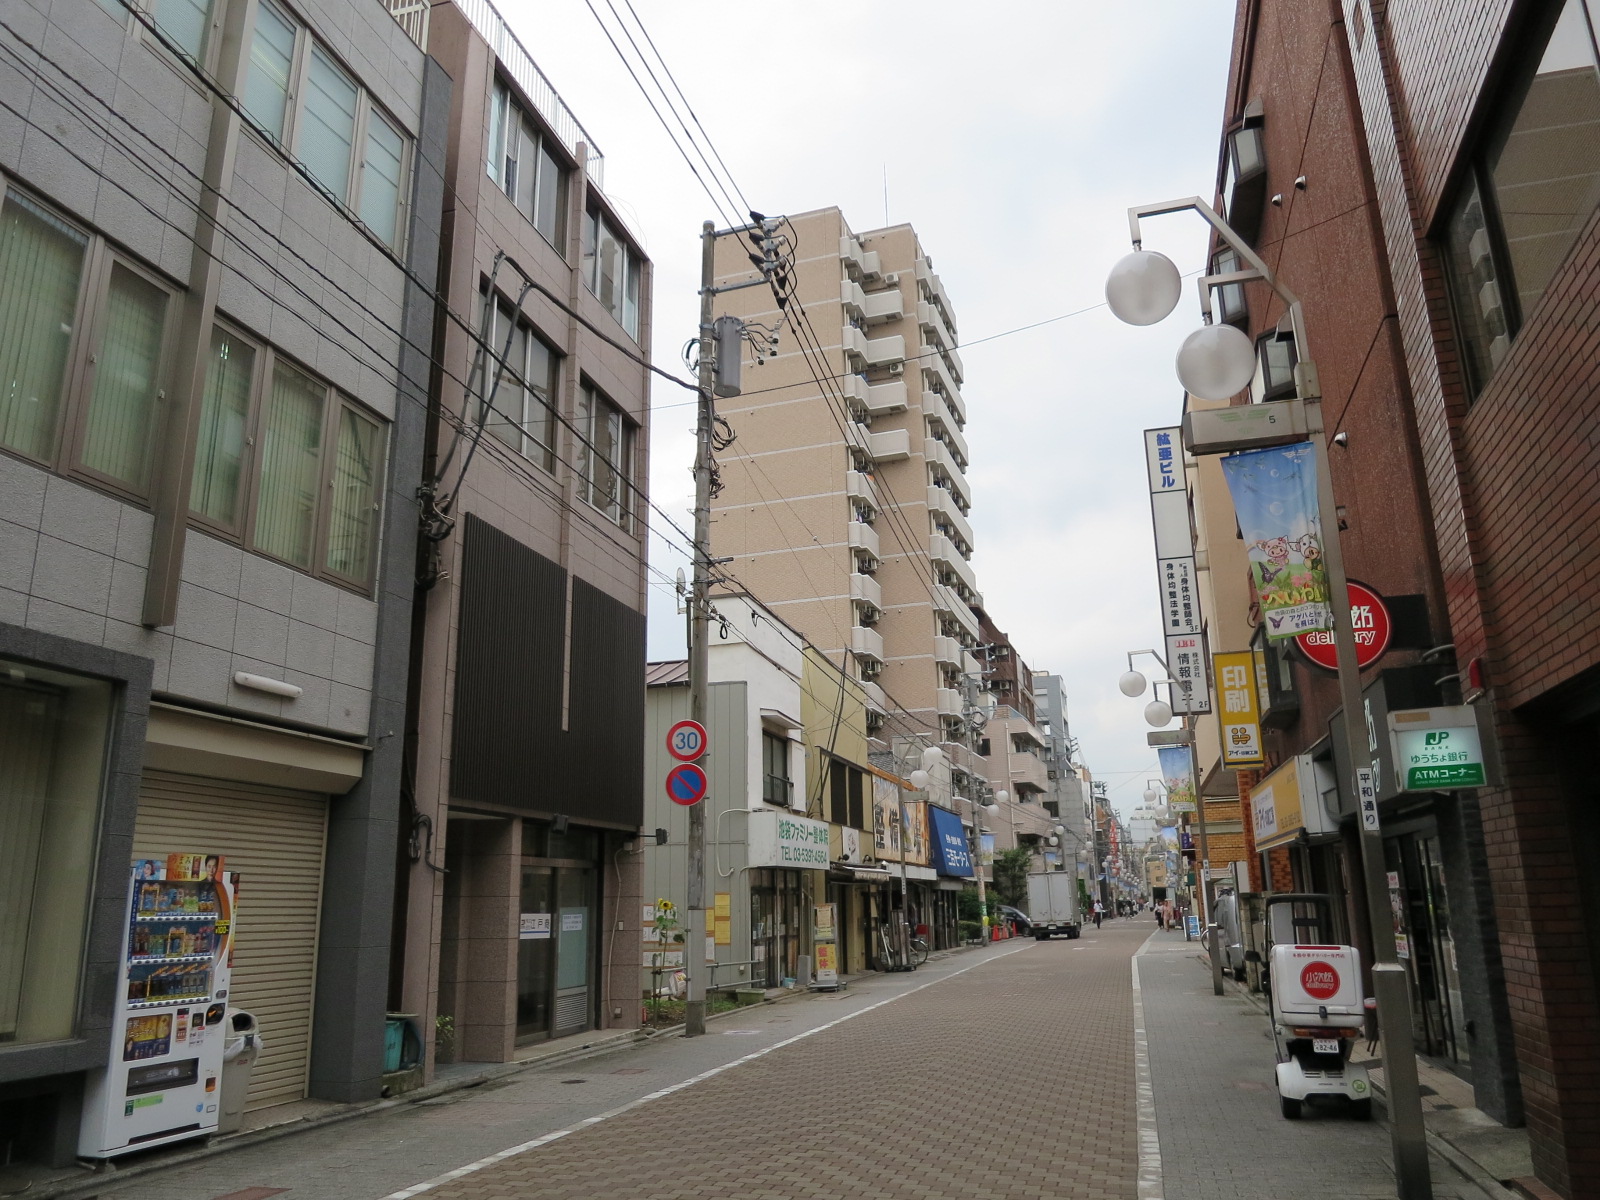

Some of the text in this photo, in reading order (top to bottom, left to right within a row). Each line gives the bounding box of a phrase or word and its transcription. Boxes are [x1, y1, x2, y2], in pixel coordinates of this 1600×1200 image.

[1222, 665, 1250, 713] 印刷
[1199, 700, 1208, 709] 2F
[675, 732, 698, 750] 30
[1425, 731, 1449, 746] JP
[1410, 751, 1468, 764] ゆうちょ銀行
[1414, 767, 1477, 779] ATMコーナー
[1360, 773, 1376, 825] 平和通り
[781, 845, 792, 860] TEL
